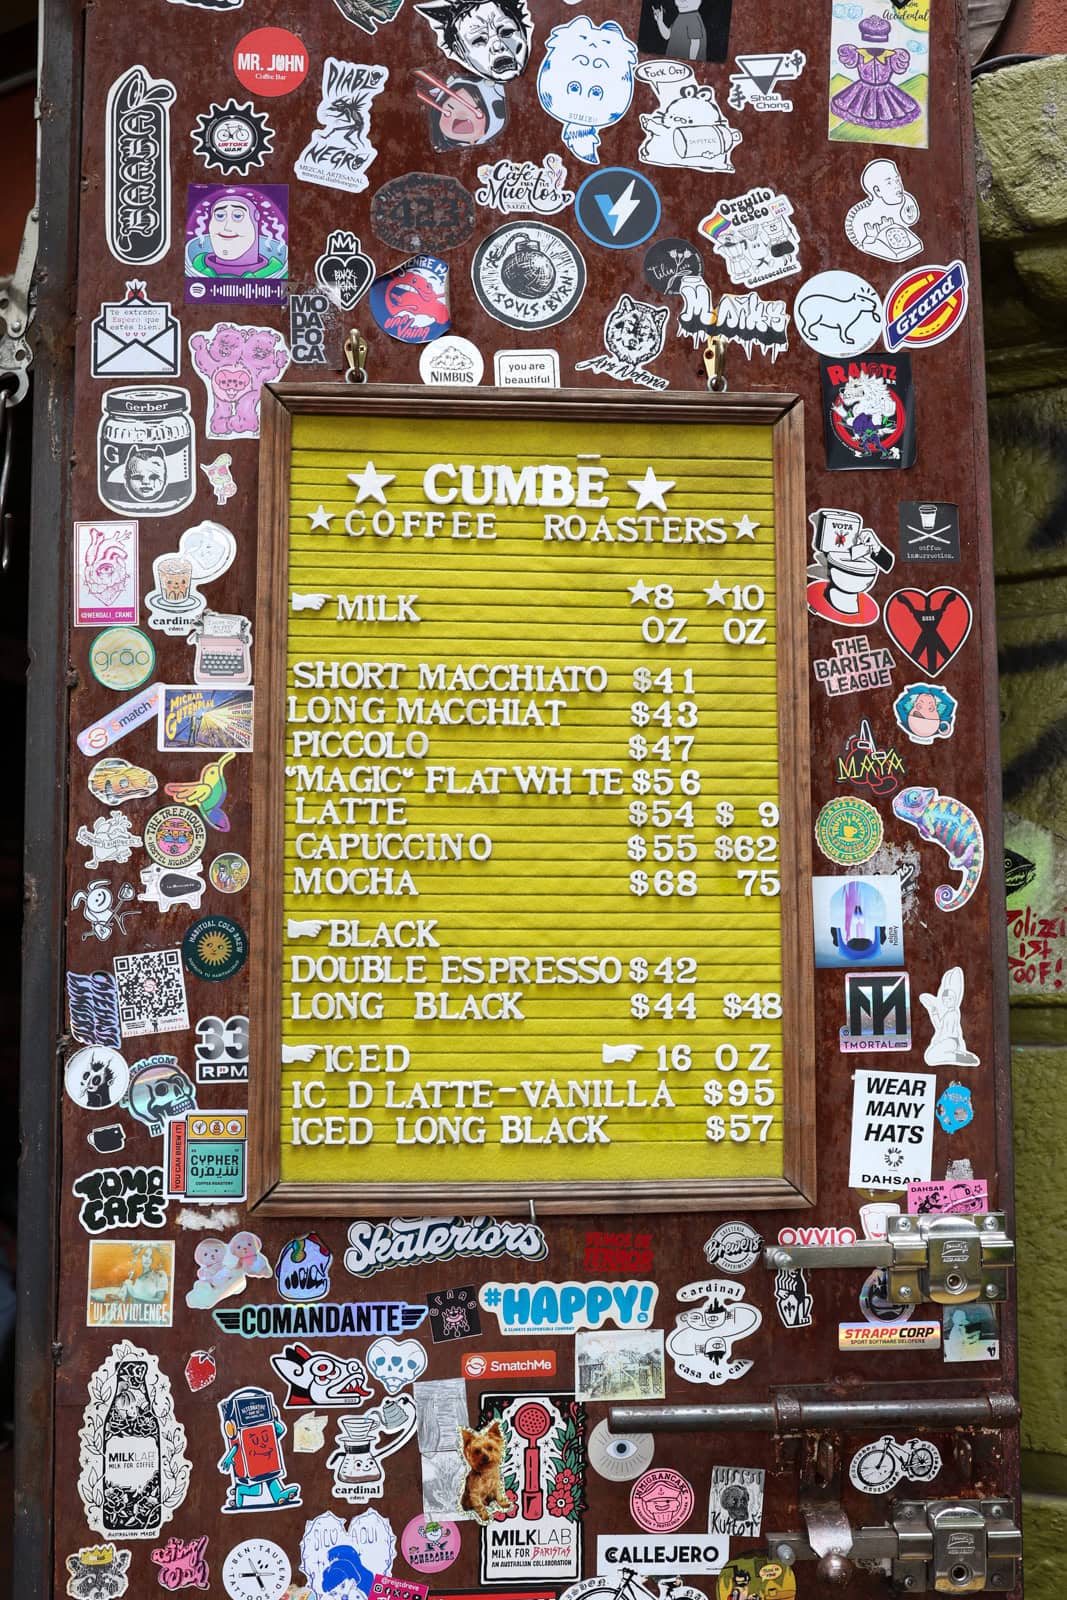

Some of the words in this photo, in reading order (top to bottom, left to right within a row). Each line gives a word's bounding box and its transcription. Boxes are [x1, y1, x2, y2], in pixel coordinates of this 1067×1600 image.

[237, 53, 264, 71] MR.
[267, 53, 304, 72] JOHN
[896, 275, 955, 335] Grand
[430, 371, 474, 383] NIMBUS
[508, 362, 524, 371] you
[504, 375, 551, 384] beautiful
[125, 401, 168, 411] Gerber
[344, 510, 498, 539] COFFEE
[543, 513, 729, 545] ROASTERS
[337, 593, 421, 623] MILK
[654, 584, 675, 609] 8
[731, 584, 766, 611] 10
[641, 616, 688, 644] OZ
[723, 617, 767, 646] OZ
[834, 637, 868, 657] THE
[815, 649, 895, 680] BARISTA
[293, 661, 407, 691] SHORT
[418, 662, 609, 693] MACCHIATO
[632, 667, 695, 695] $41
[826, 672, 892, 695] LEAGUE
[287, 695, 386, 726] LONG
[396, 696, 568, 728] MACCHIAT
[630, 700, 698, 729] $43
[292, 730, 430, 760] PICCOLO
[628, 735, 696, 763] $47
[838, 748, 906, 780] MAYA
[425, 766, 508, 795] FLAT
[631, 768, 702, 796] $56
[146, 817, 160, 835] THE
[162, 807, 205, 840] TREEHOUSE
[295, 797, 408, 826] LATTE
[628, 800, 696, 828] $54
[295, 832, 494, 862] CAPUCCINO
[626, 834, 698, 862] $55
[713, 834, 778, 863] $62
[293, 867, 420, 896] MOCHA
[629, 869, 699, 897] $68
[736, 869, 781, 898] 75
[190, 920, 217, 943] HABITUAL
[217, 920, 235, 934] COLD
[328, 918, 441, 949] BLACK
[290, 954, 428, 985] DOUBLE
[440, 955, 623, 986] ESPRESSO
[628, 955, 698, 985] $42
[290, 991, 385, 1021] LONG
[413, 991, 525, 1021] BLACK
[630, 992, 698, 1021] $44
[722, 992, 784, 1021] $48
[198, 1017, 249, 1059] 33
[324, 1044, 411, 1074] ICED
[656, 1043, 692, 1072] 16
[201, 1066, 248, 1078] RPM
[703, 1078, 777, 1107] $95
[866, 1076, 927, 1097] WEAR
[865, 1101, 925, 1119] MANY
[290, 1115, 374, 1146] ICED
[396, 1115, 487, 1145] LONG
[499, 1114, 611, 1145] BLACK
[706, 1114, 775, 1144] $57
[864, 1123, 925, 1144] HATS
[190, 1154, 239, 1166] CYPHER
[911, 1185, 945, 1193] DAHSAR
[680, 1283, 741, 1300] cardinal
[92, 1302, 169, 1323] ULTRAVIOLENCE
[484, 1284, 654, 1326] #HAPPY!
[241, 1304, 400, 1336] COMANDANTE
[844, 1328, 898, 1339] STRAPP
[898, 1326, 935, 1338] CORP
[490, 1358, 552, 1372] SmatchMe
[678, 1362, 702, 1379] casa
[708, 1370, 723, 1380] de
[334, 1485, 381, 1496] cardinal
[491, 1528, 572, 1547] MILKLAB
[231, 1546, 251, 1565] BEN
[491, 1548, 512, 1559] MILK
[515, 1548, 530, 1558] FOR
[605, 1546, 719, 1563] CALLEJERO
